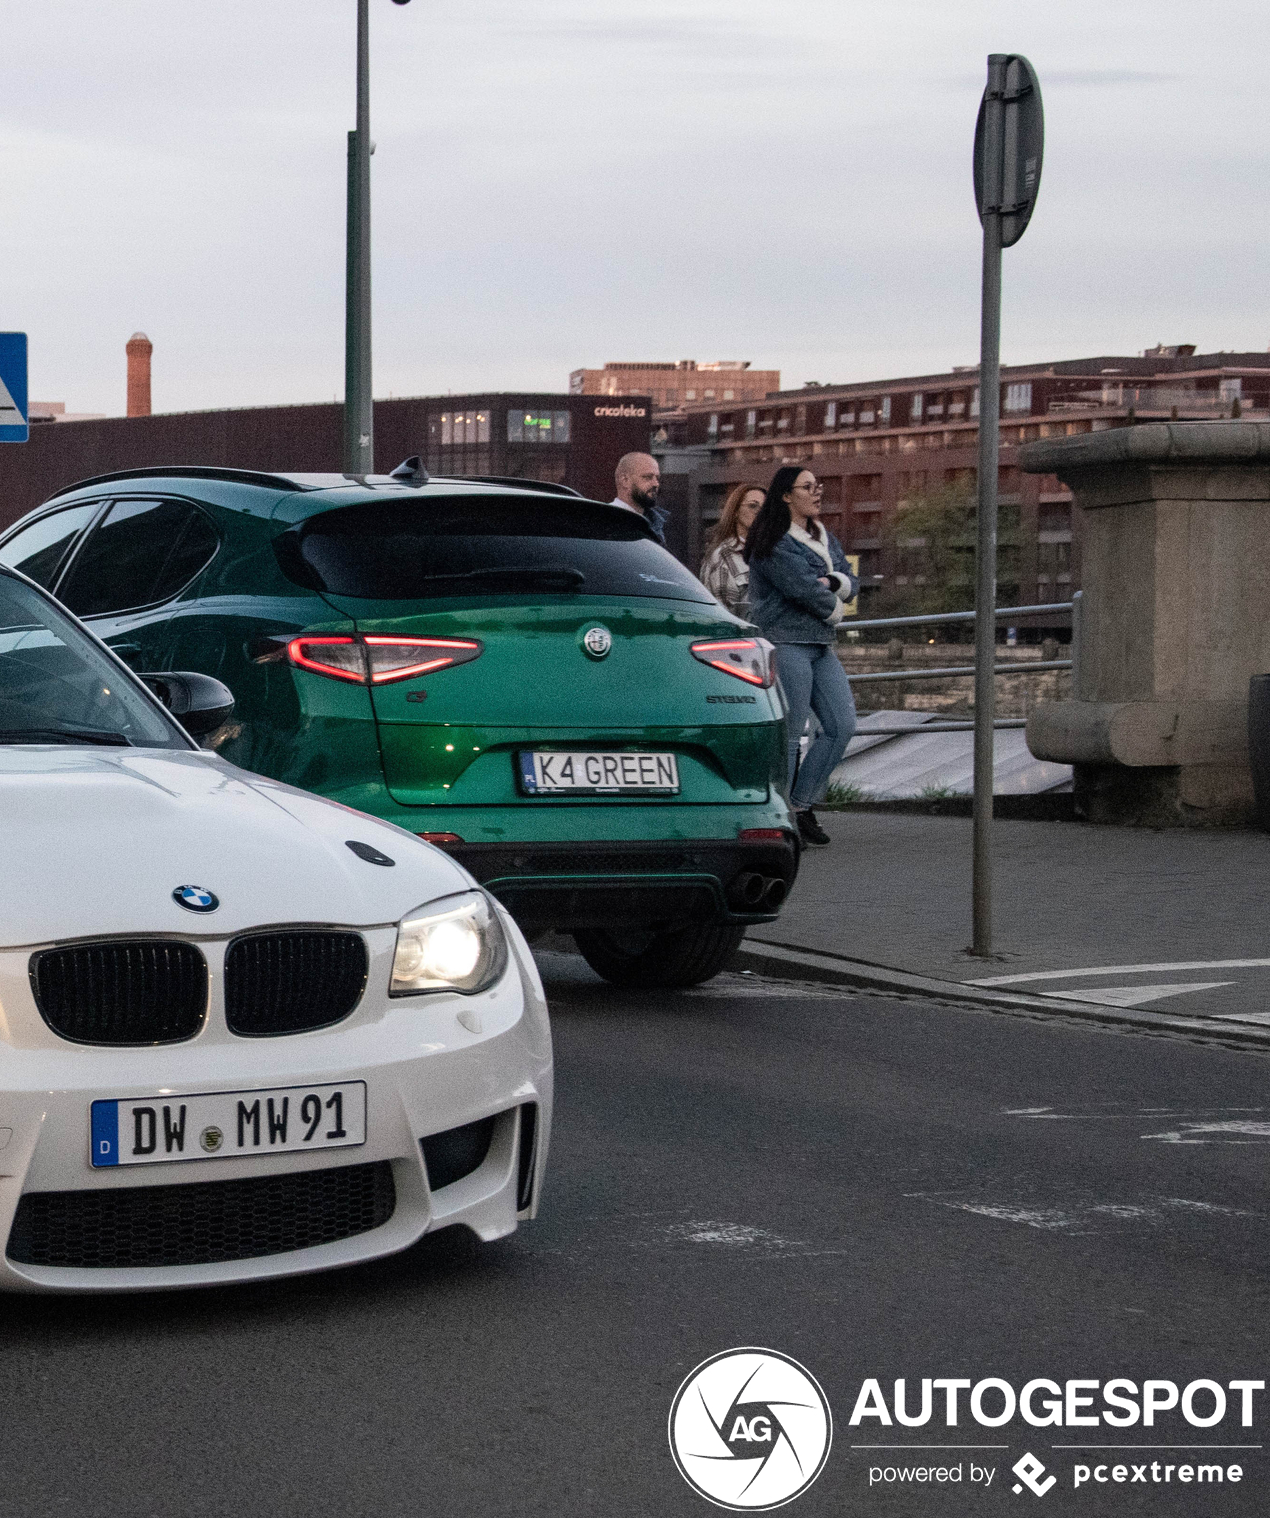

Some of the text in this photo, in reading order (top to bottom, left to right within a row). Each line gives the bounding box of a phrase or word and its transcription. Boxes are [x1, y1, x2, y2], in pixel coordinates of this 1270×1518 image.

[705, 695, 757, 704] STELVIO
[538, 755, 675, 785] K4 GREEN
[524, 774, 536, 783] PL
[132, 1104, 187, 1155] DW
[99, 1140, 111, 1154] D
